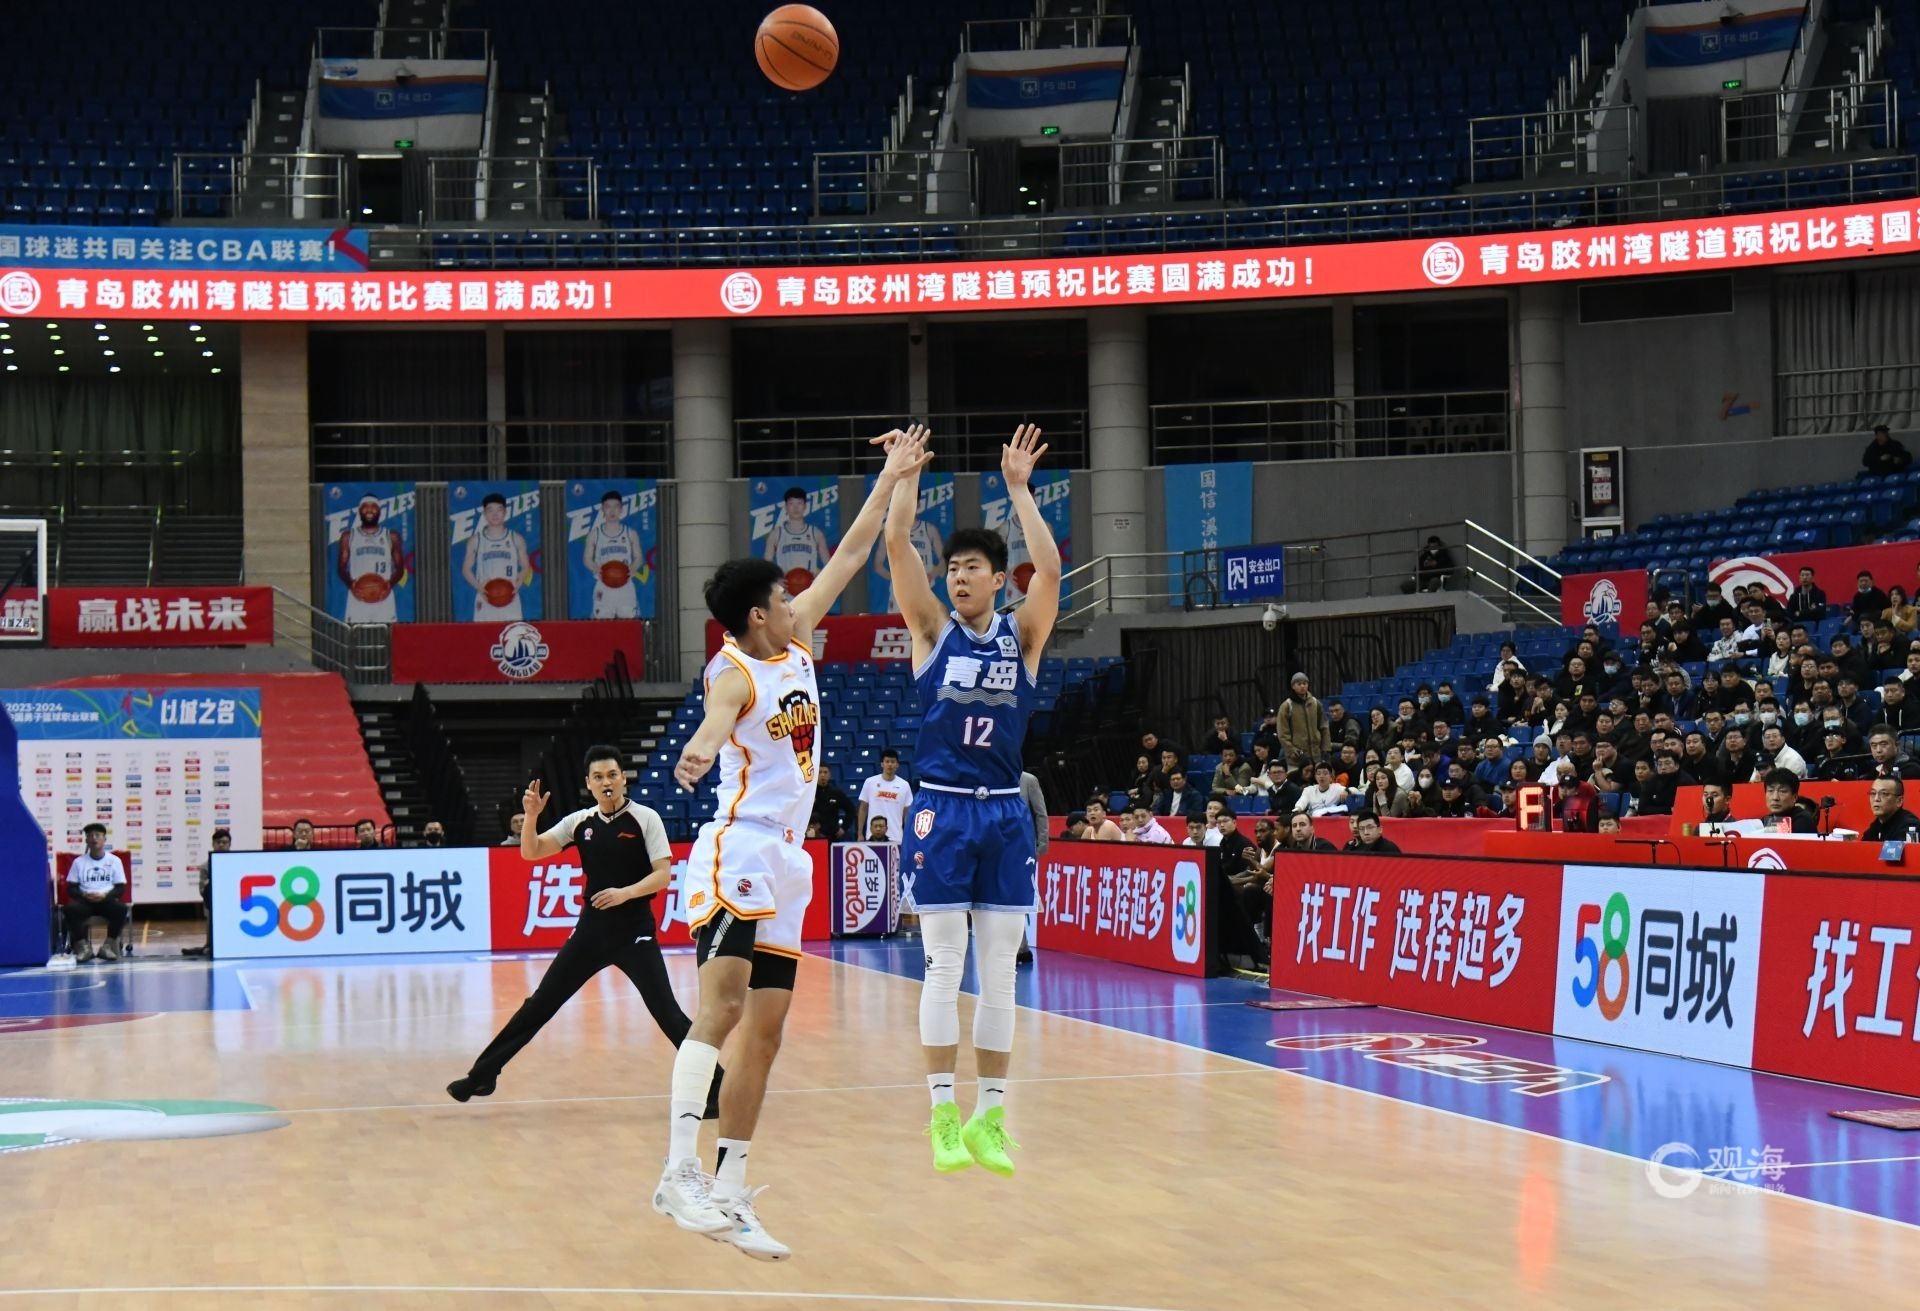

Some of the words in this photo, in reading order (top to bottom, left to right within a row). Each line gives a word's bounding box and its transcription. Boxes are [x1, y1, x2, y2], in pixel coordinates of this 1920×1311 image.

[1480, 209, 1920, 275] 青岛胶州湾隧道预祝比赛圆
[57, 278, 612, 311] 青岛胶州湾隧道预祝比赛圆满成功！
[776, 258, 1314, 307] 青岛胶州湾隧道预祝比赛圆满成功！
[1248, 558, 1281, 574] 安全出口
[1254, 574, 1275, 585] EXIT
[78, 596, 247, 633] 赢战未来
[942, 655, 1018, 691] 青岛
[160, 698, 236, 725] 以城之名
[963, 716, 994, 747] 12
[239, 865, 466, 941] 58同城
[865, 858, 879, 911] 百岁山
[1043, 862, 1093, 931] 找工作
[1095, 866, 1166, 941] 选择超多
[1175, 879, 1197, 947] 58
[1296, 882, 1381, 971] 找工作
[1389, 888, 1525, 989] 选择超多
[1572, 892, 1738, 1029] 58同城
[1803, 920, 1920, 1042] 找工
